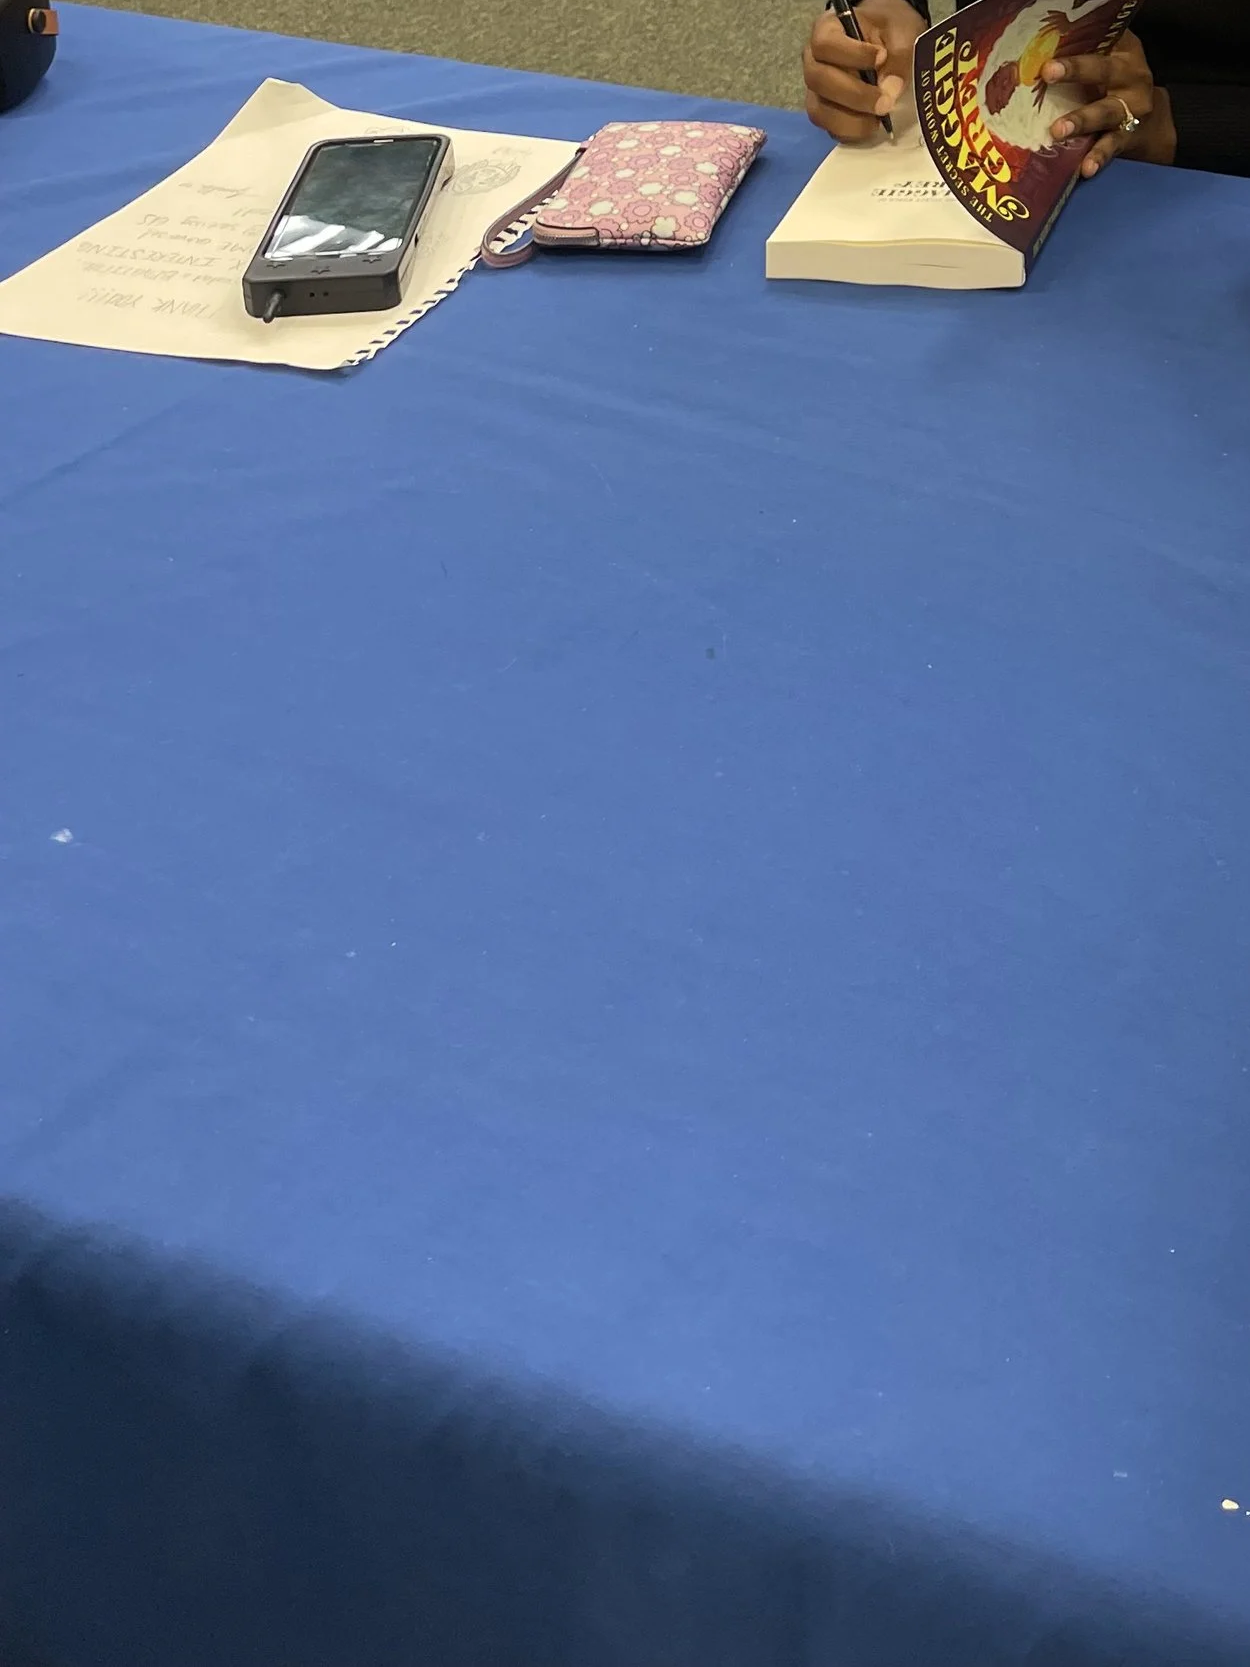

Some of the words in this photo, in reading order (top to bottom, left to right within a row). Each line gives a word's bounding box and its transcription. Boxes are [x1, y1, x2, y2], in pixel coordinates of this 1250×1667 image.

[920, 69, 930, 93] OF
[924, 97, 944, 141] WORLD
[934, 27, 1030, 221] MAGGIE
[956, 40, 1013, 184] GREY
[936, 144, 969, 195] SECRET
[971, 192, 995, 223] THE
